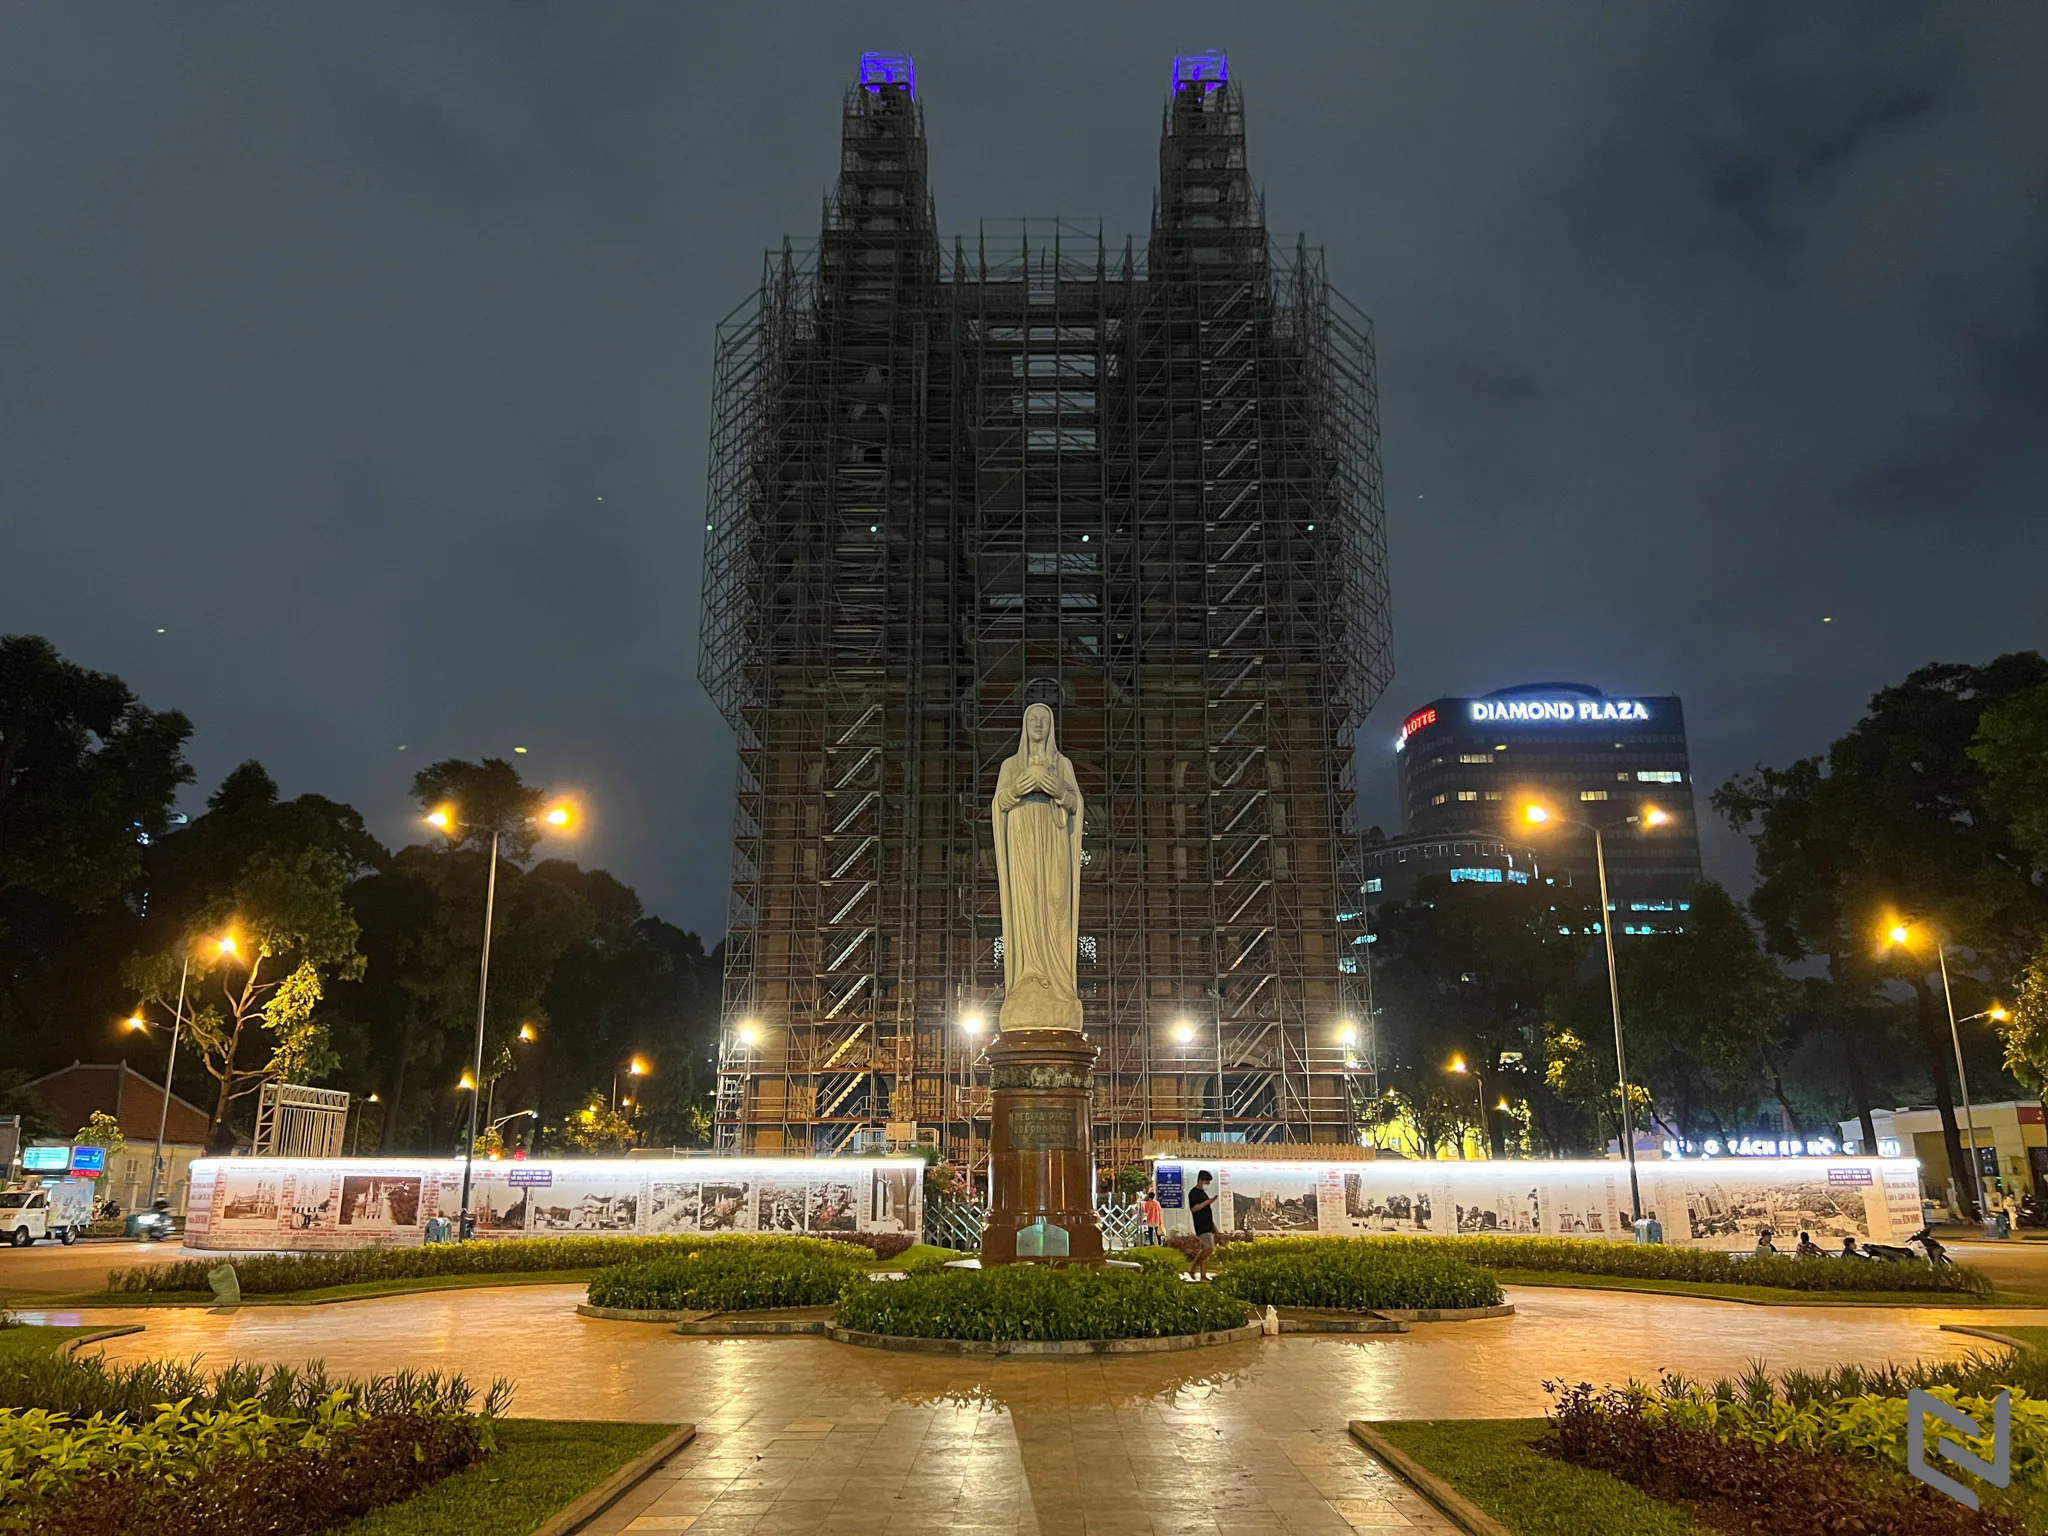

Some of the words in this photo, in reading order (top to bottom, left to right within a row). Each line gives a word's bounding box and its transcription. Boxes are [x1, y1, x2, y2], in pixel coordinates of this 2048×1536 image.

[1472, 701, 1575, 720] DIAMOND
[1579, 701, 1649, 720] PLAZA
[1407, 709, 1437, 735] LOTTE
